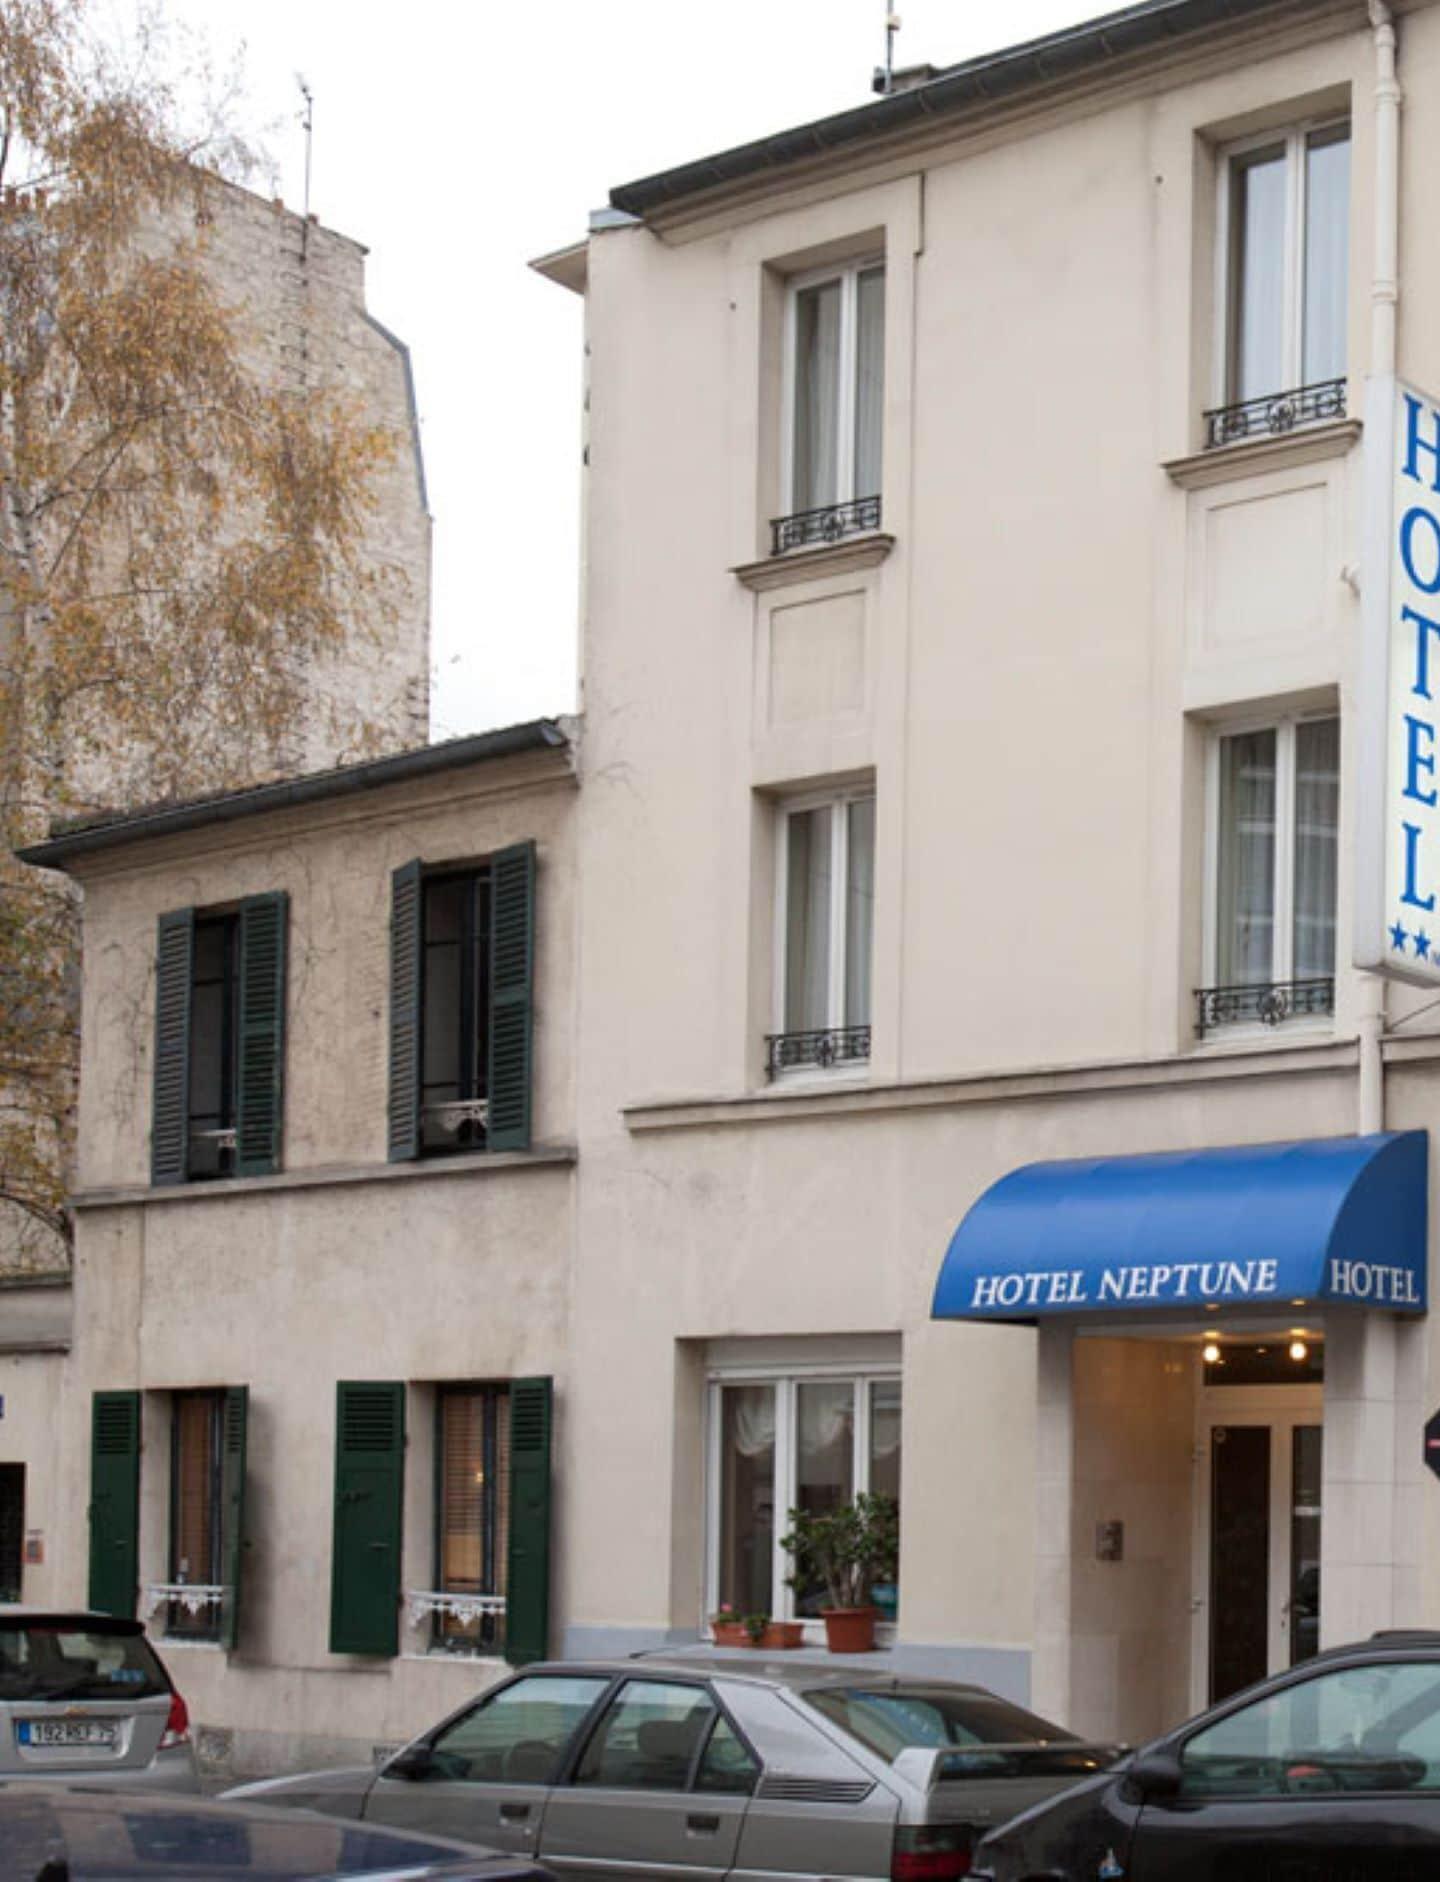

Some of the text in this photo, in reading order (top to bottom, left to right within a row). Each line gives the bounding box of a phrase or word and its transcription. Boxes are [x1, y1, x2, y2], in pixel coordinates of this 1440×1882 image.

[971, 1259, 1278, 1307] HOTEL NEPTUNE
[1330, 1258, 1420, 1303] HOTEL
